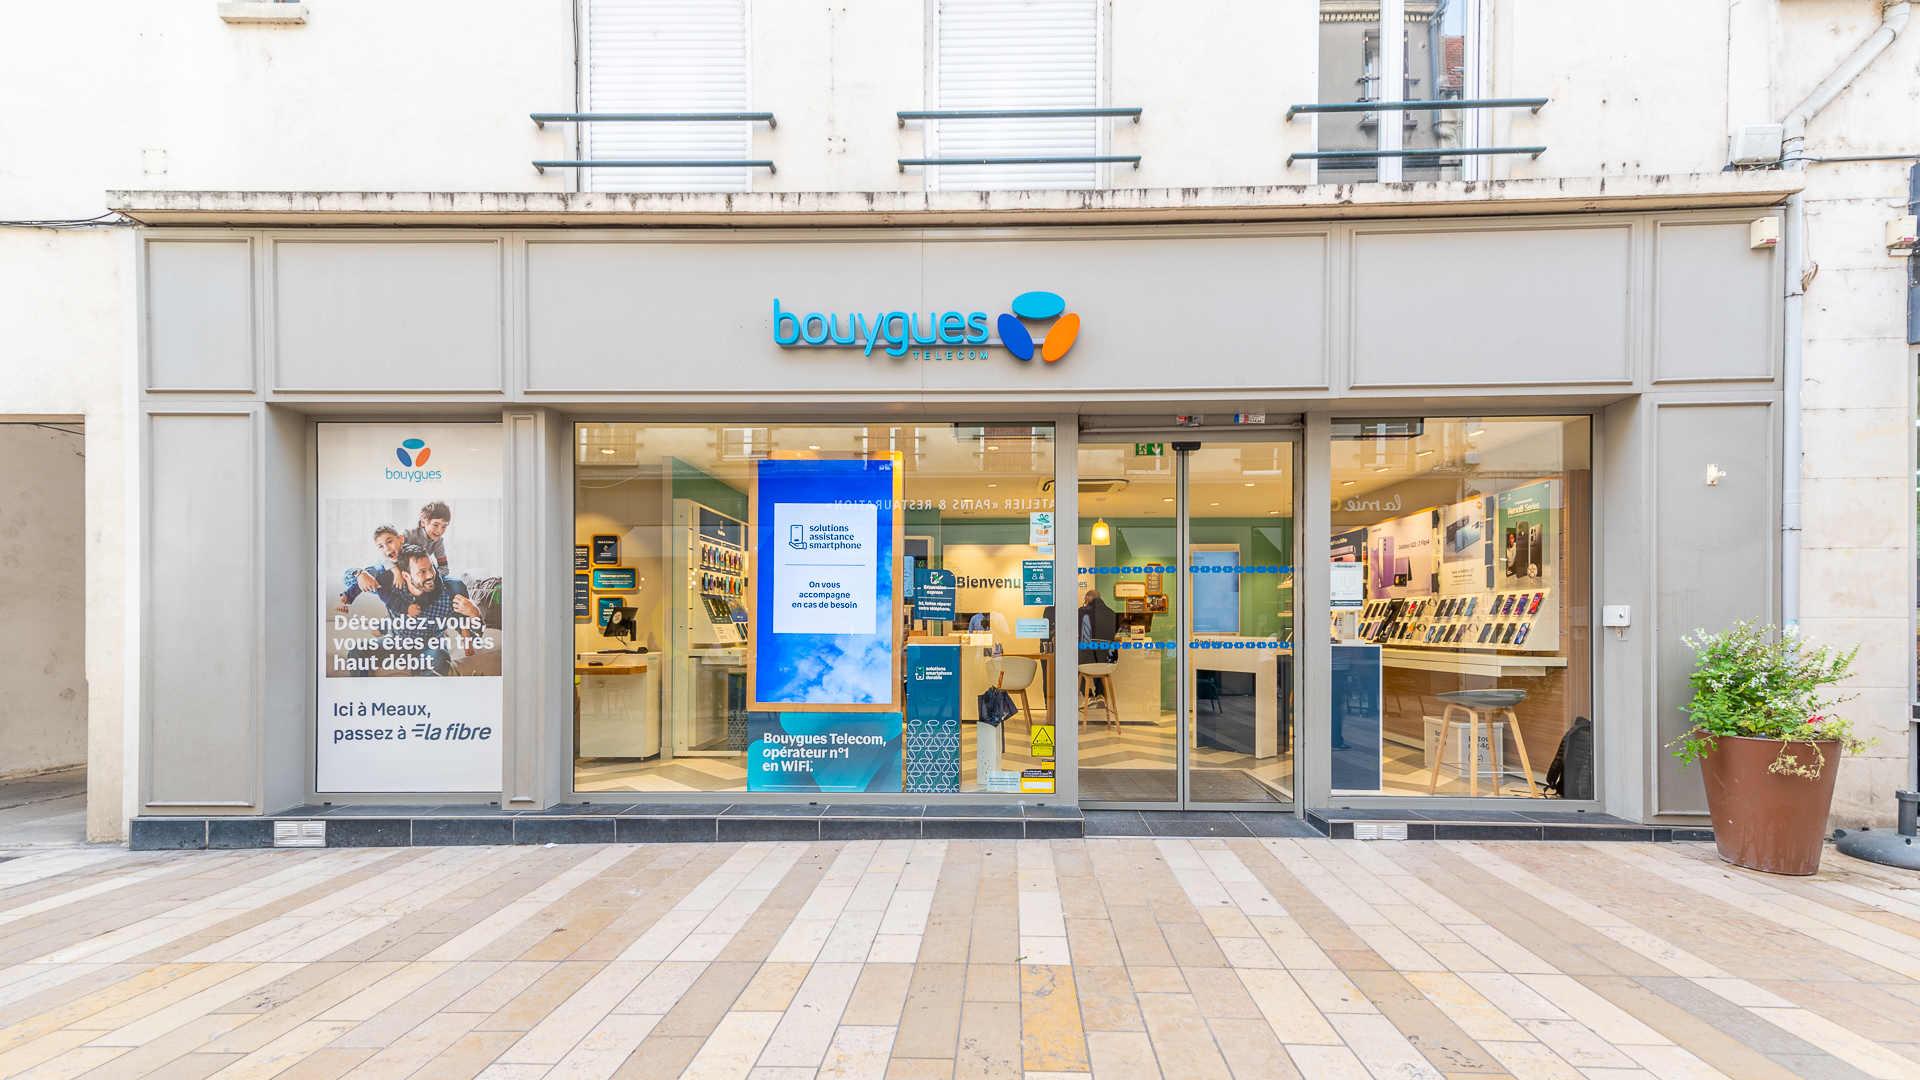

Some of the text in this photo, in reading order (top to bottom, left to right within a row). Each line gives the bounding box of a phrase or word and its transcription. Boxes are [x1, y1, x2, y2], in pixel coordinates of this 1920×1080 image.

[774, 298, 989, 357] bouygues
[912, 351, 989, 360] TELECOM
[385, 467, 442, 483] bouygues
[1507, 505, 1523, 515] Reno8
[1525, 502, 1540, 511] Series
[809, 524, 849, 532] solutions
[809, 533, 854, 541] assistance
[809, 542, 862, 551] smartphone
[799, 591, 851, 600] accompagne
[818, 601, 829, 609] de
[830, 601, 858, 609] besoin
[334, 614, 487, 632] Détendez-vous,
[333, 635, 494, 650] vous êtes en très
[333, 653, 435, 671] haut débit
[333, 702, 431, 719] Ici à Meaux,
[333, 723, 492, 744] passez à la fibre
[763, 732, 887, 747] Bouygues Telecom,
[762, 747, 849, 760] opérateur n°1
[762, 761, 778, 772] en
